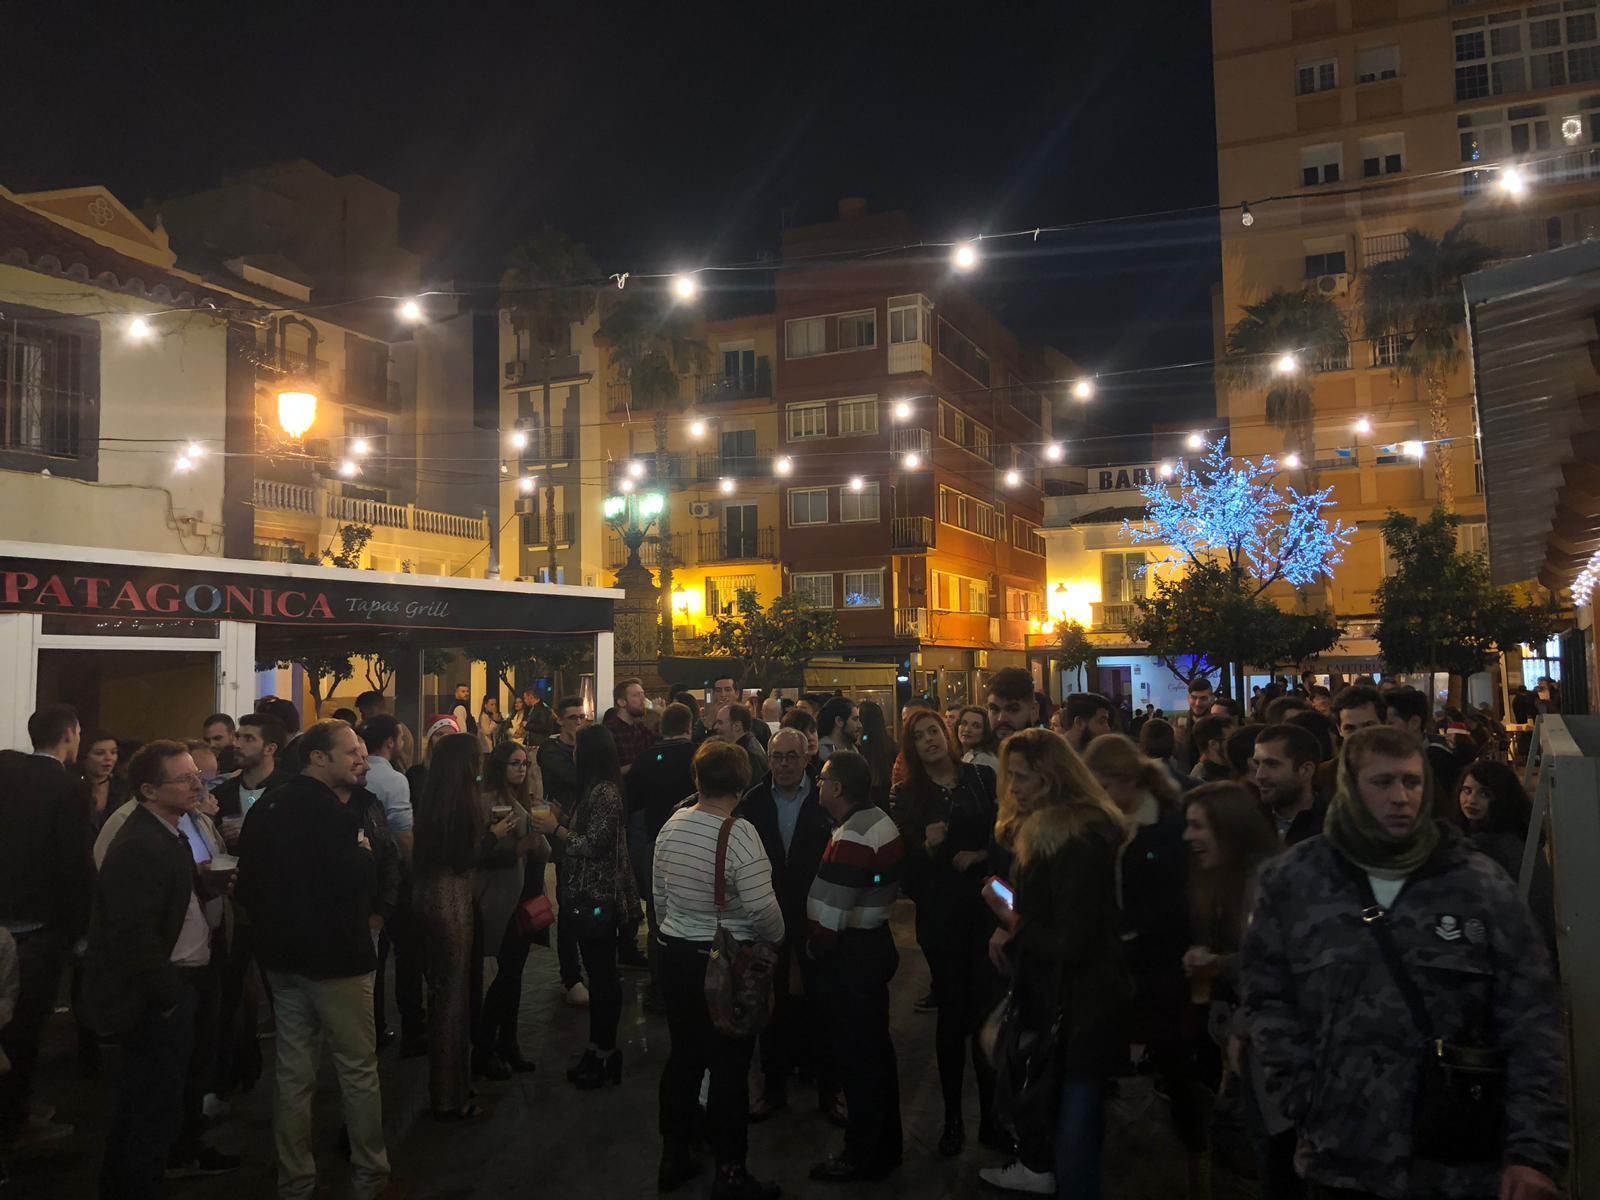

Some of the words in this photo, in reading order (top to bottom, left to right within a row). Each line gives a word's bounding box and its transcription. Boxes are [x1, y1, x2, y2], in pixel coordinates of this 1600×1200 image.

[0, 571, 335, 619] PATAGONICA
[345, 597, 401, 620] Tapas
[405, 601, 448, 618] Grill
